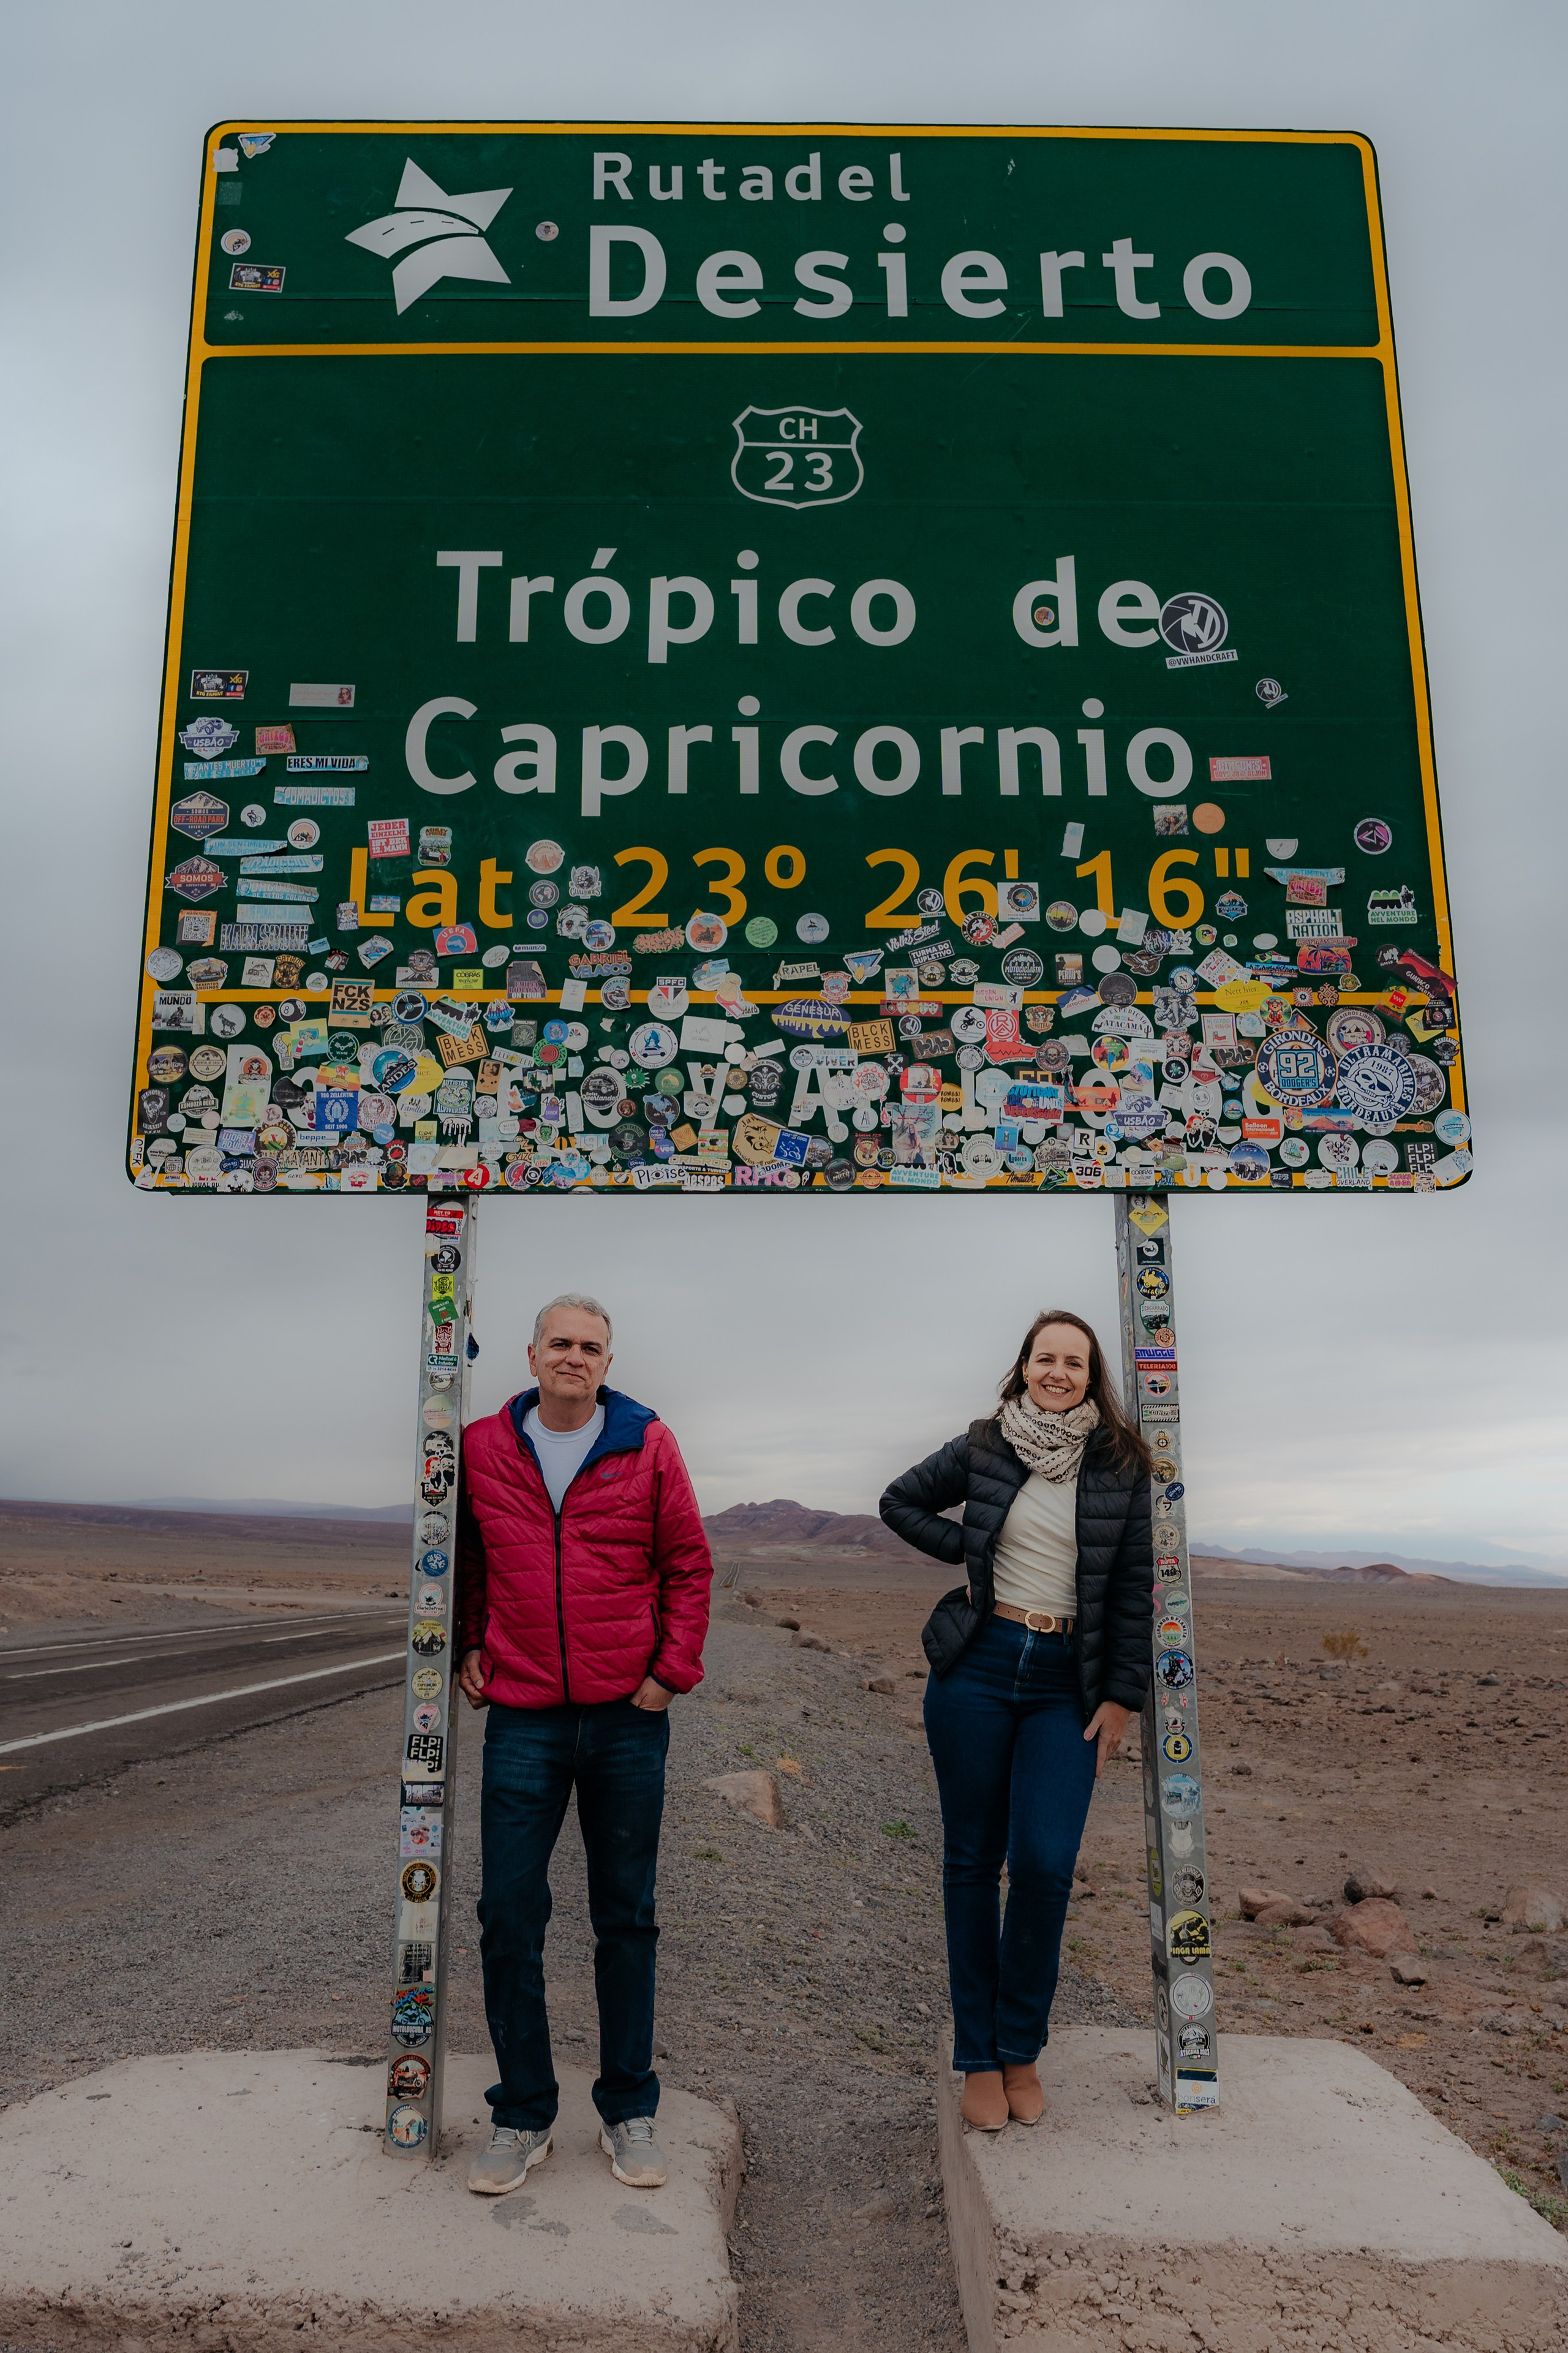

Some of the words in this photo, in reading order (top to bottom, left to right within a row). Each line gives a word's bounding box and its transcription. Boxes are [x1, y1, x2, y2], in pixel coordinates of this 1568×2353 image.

[589, 223, 1252, 320] Desierto
[778, 418, 817, 440] CH
[764, 451, 833, 492] 23
[437, 548, 916, 663] Trópico
[1012, 555, 1161, 648] de
[1168, 651, 1235, 667] @VWHANDCRAFT
[193, 736, 225, 747] USBÃO
[405, 695, 1193, 817] Capricornio
[198, 761, 224, 771] ANTES
[225, 760, 256, 769] MUERTO
[288, 757, 313, 769] ERES
[315, 757, 328, 768] MI
[329, 757, 356, 768] VIDA
[371, 821, 405, 831] JEDER
[372, 838, 386, 847] IST
[384, 844, 408, 853] MANN
[349, 847, 513, 929] Lat
[1287, 910, 1341, 924] ASPHALT
[442, 927, 466, 938] UEFA
[903, 927, 913, 937] the
[914, 920, 940, 941] Steel
[1292, 924, 1337, 937] NATION
[220, 924, 308, 951] KARLSRUHE
[569, 950, 631, 965] GABRIEL
[911, 946, 937, 959] TURMA
[938, 943, 949, 951] DO
[913, 950, 952, 965] SUPLETIVO
[276, 954, 304, 967] SATIROS
[569, 962, 632, 978] VELASCO
[782, 965, 820, 975] RAPEL
[1005, 965, 1041, 974] MOTOCICLISTA
[1406, 971, 1430, 989] GUANACO
[333, 984, 371, 998] FCK
[1175, 984, 1196, 994] AUSTRALIA
[1243, 985, 1259, 994] hier.
[159, 996, 192, 1005] MUNDO
[331, 998, 371, 1011] NZS
[1066, 997, 1091, 1008] INTOCHILE
[786, 1003, 840, 1018] GENESUR
[1109, 1005, 1147, 1024] EXPEDIÇÃO
[428, 1011, 469, 1033] AVVENTURE
[1335, 1011, 1359, 1022] VIAJEROS
[1359, 1011, 1376, 1025] LIBRES
[439, 1022, 467, 1040] MONDO
[852, 1023, 889, 1038] BLCK
[1103, 1020, 1143, 1030] ATACAMA
[853, 1035, 891, 1051] MESS
[1262, 1030, 1331, 1057] GIRONDINS
[447, 1041, 484, 1062] MESS
[765, 1060, 780, 1070] BONES
[1279, 1051, 1314, 1078] 92
[1370, 1060, 1395, 1076] 1987
[380, 1060, 417, 1092] ANDES
[1340, 1044, 1416, 1103] ULTRAMARINES
[442, 1079, 468, 1087] AUTISTAS
[1281, 1077, 1317, 1088] DODGER'S
[752, 1092, 777, 1100] CUSTOM
[1008, 1085, 1058, 1098] STUTTGART
[1264, 1082, 1331, 1107] BORDEAUX
[436, 1103, 469, 1114] ALVIVERDES
[1337, 1084, 1400, 1122] BORDEAUX
[1124, 1115, 1155, 1126] USBÃO
[222, 1131, 252, 1143] WORST
[618, 1125, 643, 1137] BARONS
[300, 1133, 326, 1143] beppe
[1079, 1133, 1090, 1146] R
[222, 1141, 250, 1150] ADVICE
[1407, 1144, 1433, 1153] FLP!
[1008, 1153, 1027, 1163] Lugares
[1408, 1154, 1435, 1163] FLP!
[467, 1167, 483, 1186] A
[891, 1169, 940, 1180] AVVENTURE
[1076, 1166, 1101, 1177] 306
[1336, 1167, 1370, 1180] CHILE
[907, 1176, 939, 1186] MONDO
[428, 1355, 438, 1365] CR
[1158, 1617, 1169, 1639] GIRANDO
[412, 1736, 441, 1748] FLP!
[410, 1747, 440, 1760] FLP!
[393, 2023, 424, 2034] MOTOLOUCURA
[425, 2025, 432, 2034] RS
[1180, 2047, 1200, 2057] ATACAMA
[1200, 2047, 1210, 2057] 2023
